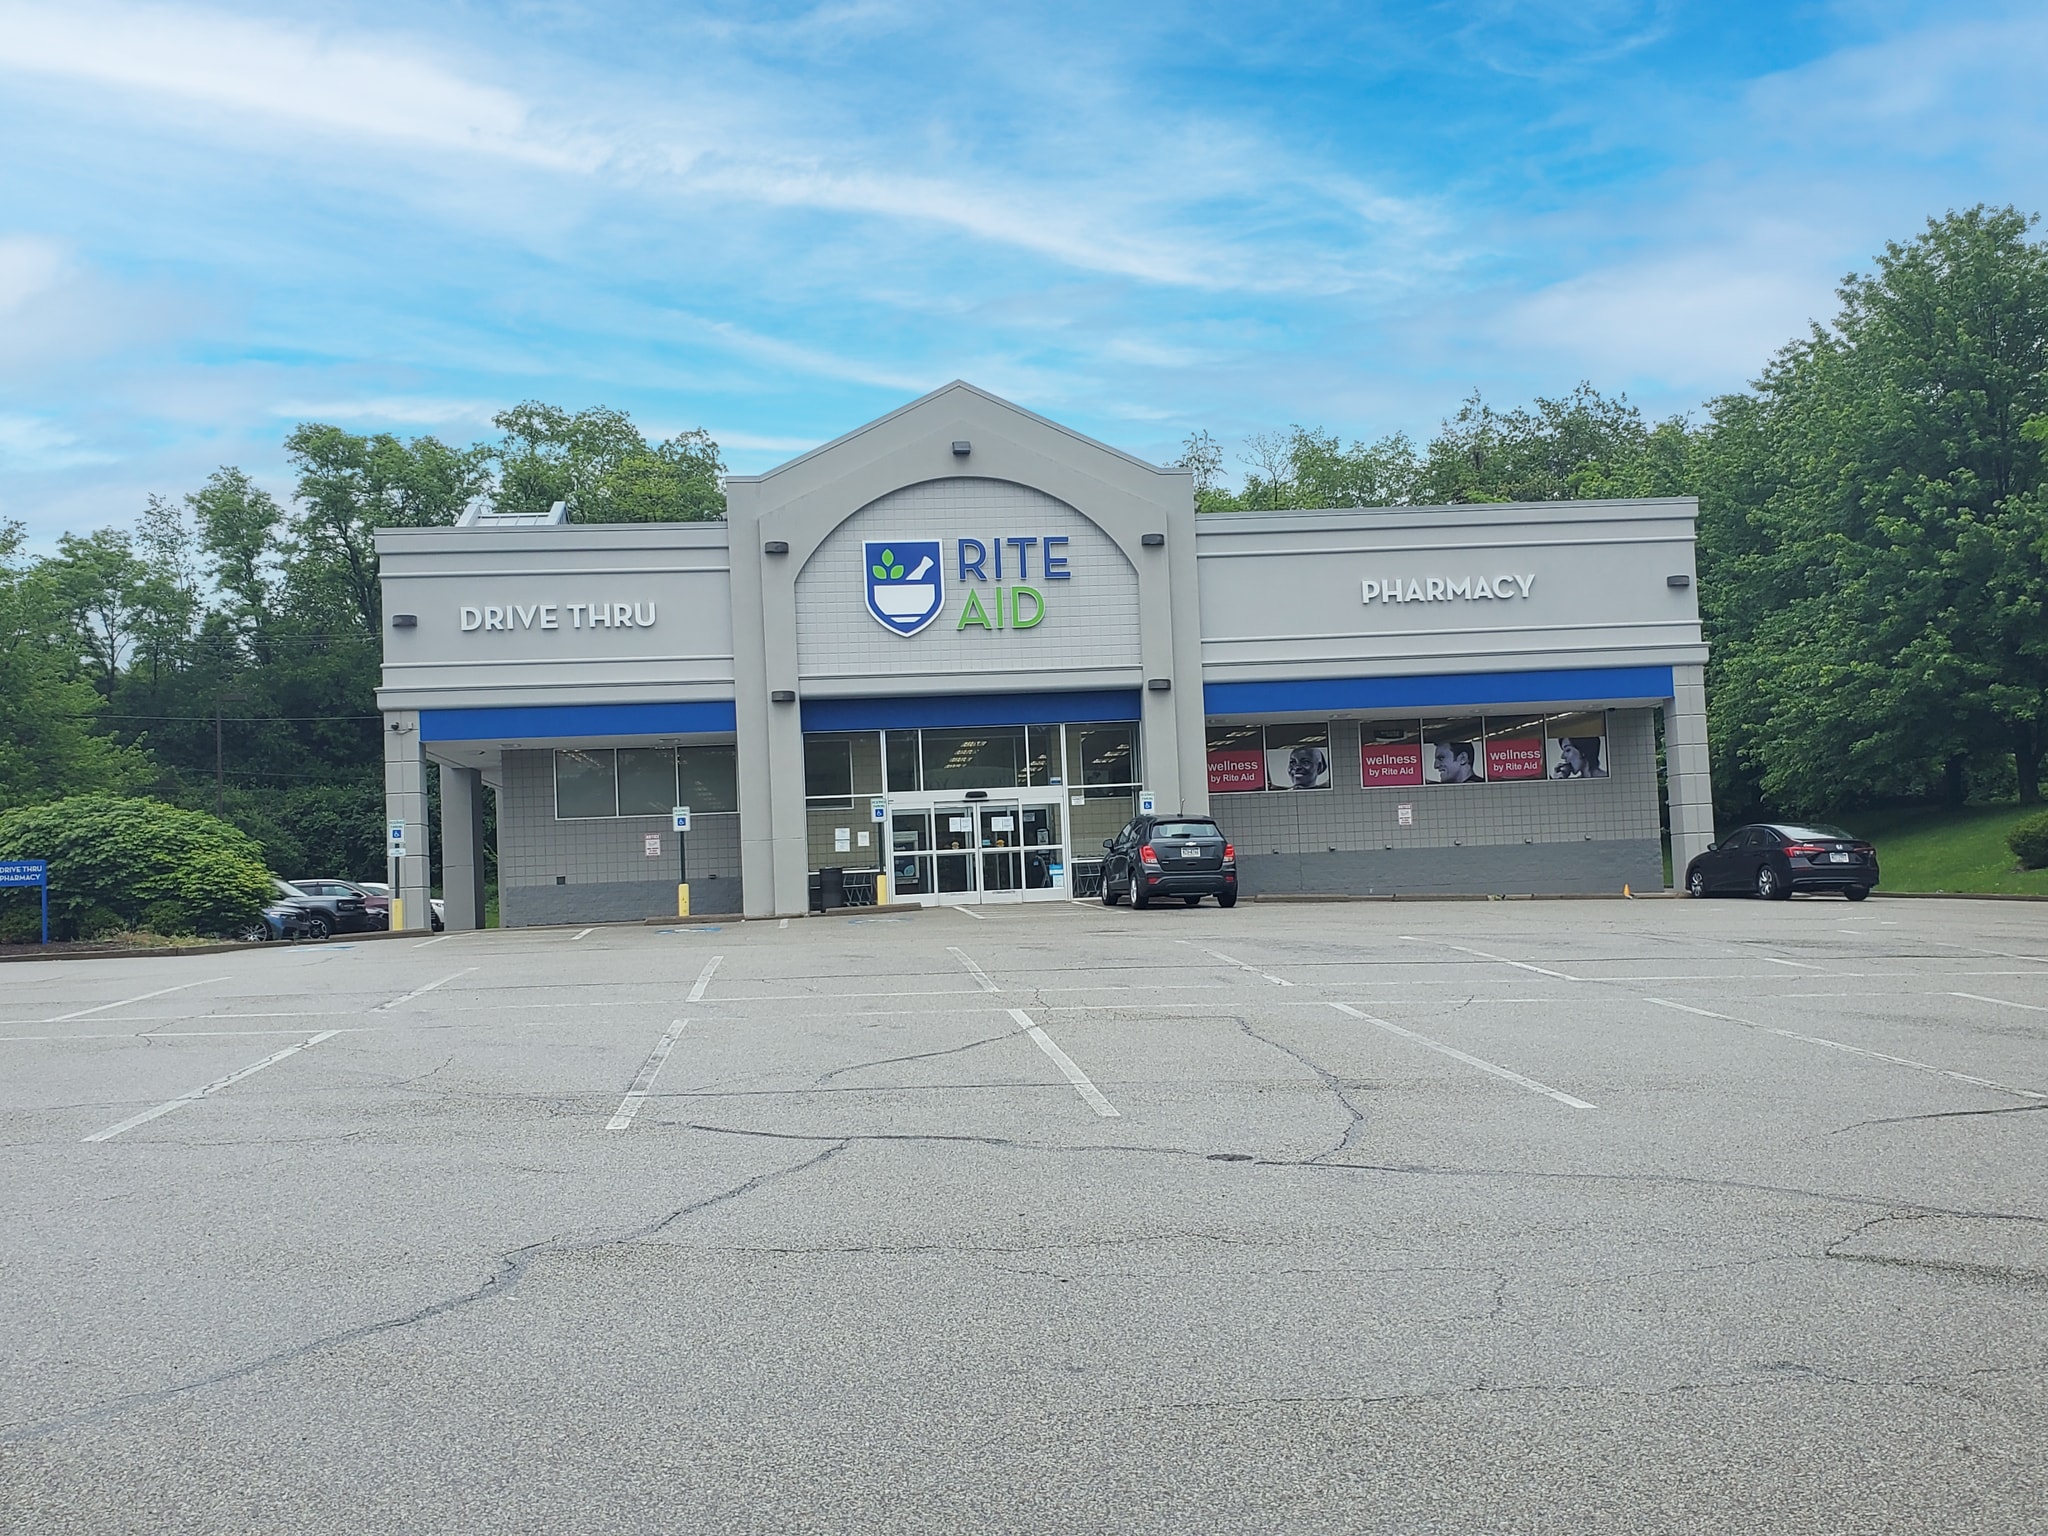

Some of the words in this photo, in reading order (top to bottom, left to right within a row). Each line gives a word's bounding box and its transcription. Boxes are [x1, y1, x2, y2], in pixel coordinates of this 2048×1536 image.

[957, 536, 1071, 581] RITE
[1361, 573, 1536, 604] PHARMACY
[957, 586, 1045, 630] AID
[459, 604, 559, 631] DRIVE
[566, 602, 656, 628] THRU
[1365, 754, 1417, 765] wellness
[1490, 749, 1540, 760] wellness
[1208, 760, 1258, 771] wellness
[1493, 764, 1503, 772] by
[1369, 768, 1379, 777] by
[1382, 767, 1398, 775] Rite
[1210, 774, 1220, 783] by
[1223, 773, 1239, 781] Rite
